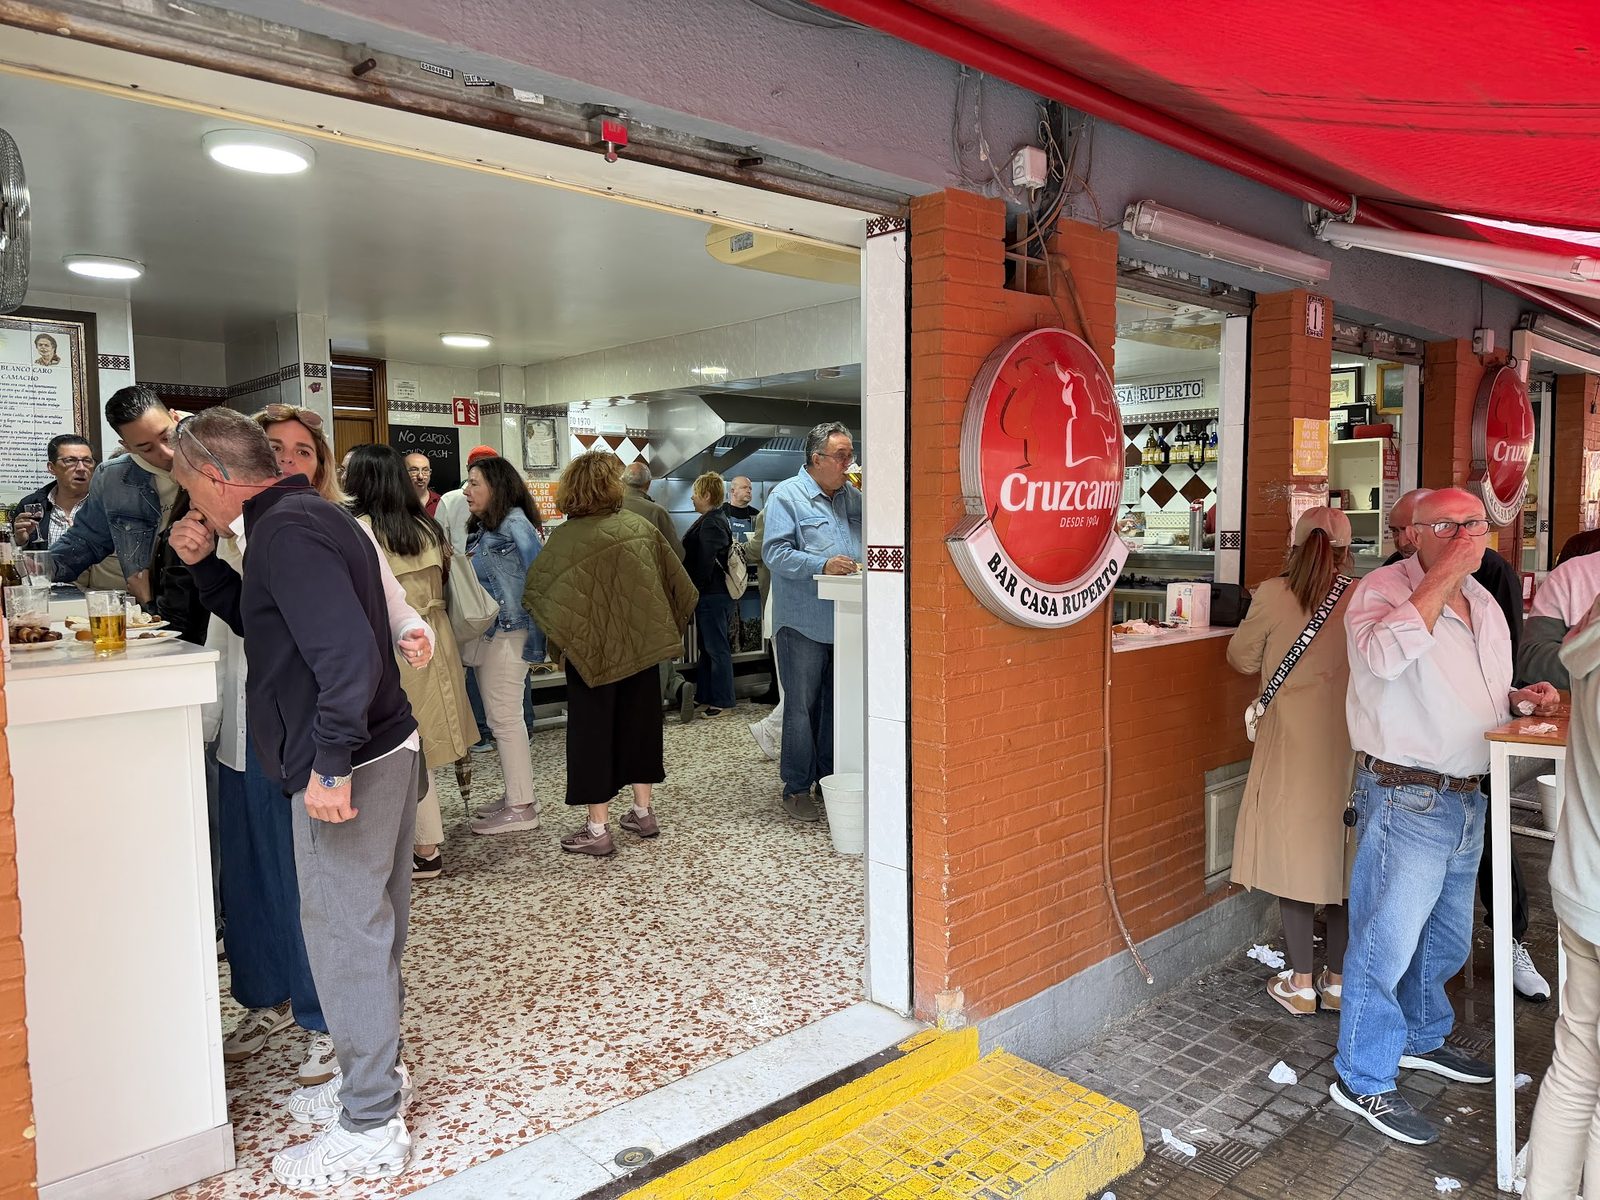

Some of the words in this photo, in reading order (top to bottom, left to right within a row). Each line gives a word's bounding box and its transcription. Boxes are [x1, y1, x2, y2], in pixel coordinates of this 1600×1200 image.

[1118, 390, 1134, 402] SA
[1140, 383, 1201, 401] RUPERTO
[398, 430, 416, 444] NO
[419, 432, 452, 445] CARDS
[1000, 472, 1121, 516] Cruzcamp
[1060, 516, 1084, 528] DESDE
[987, 552, 1018, 598] BAR
[1020, 587, 1058, 616] CASA
[1062, 558, 1119, 616] RUPERTO
